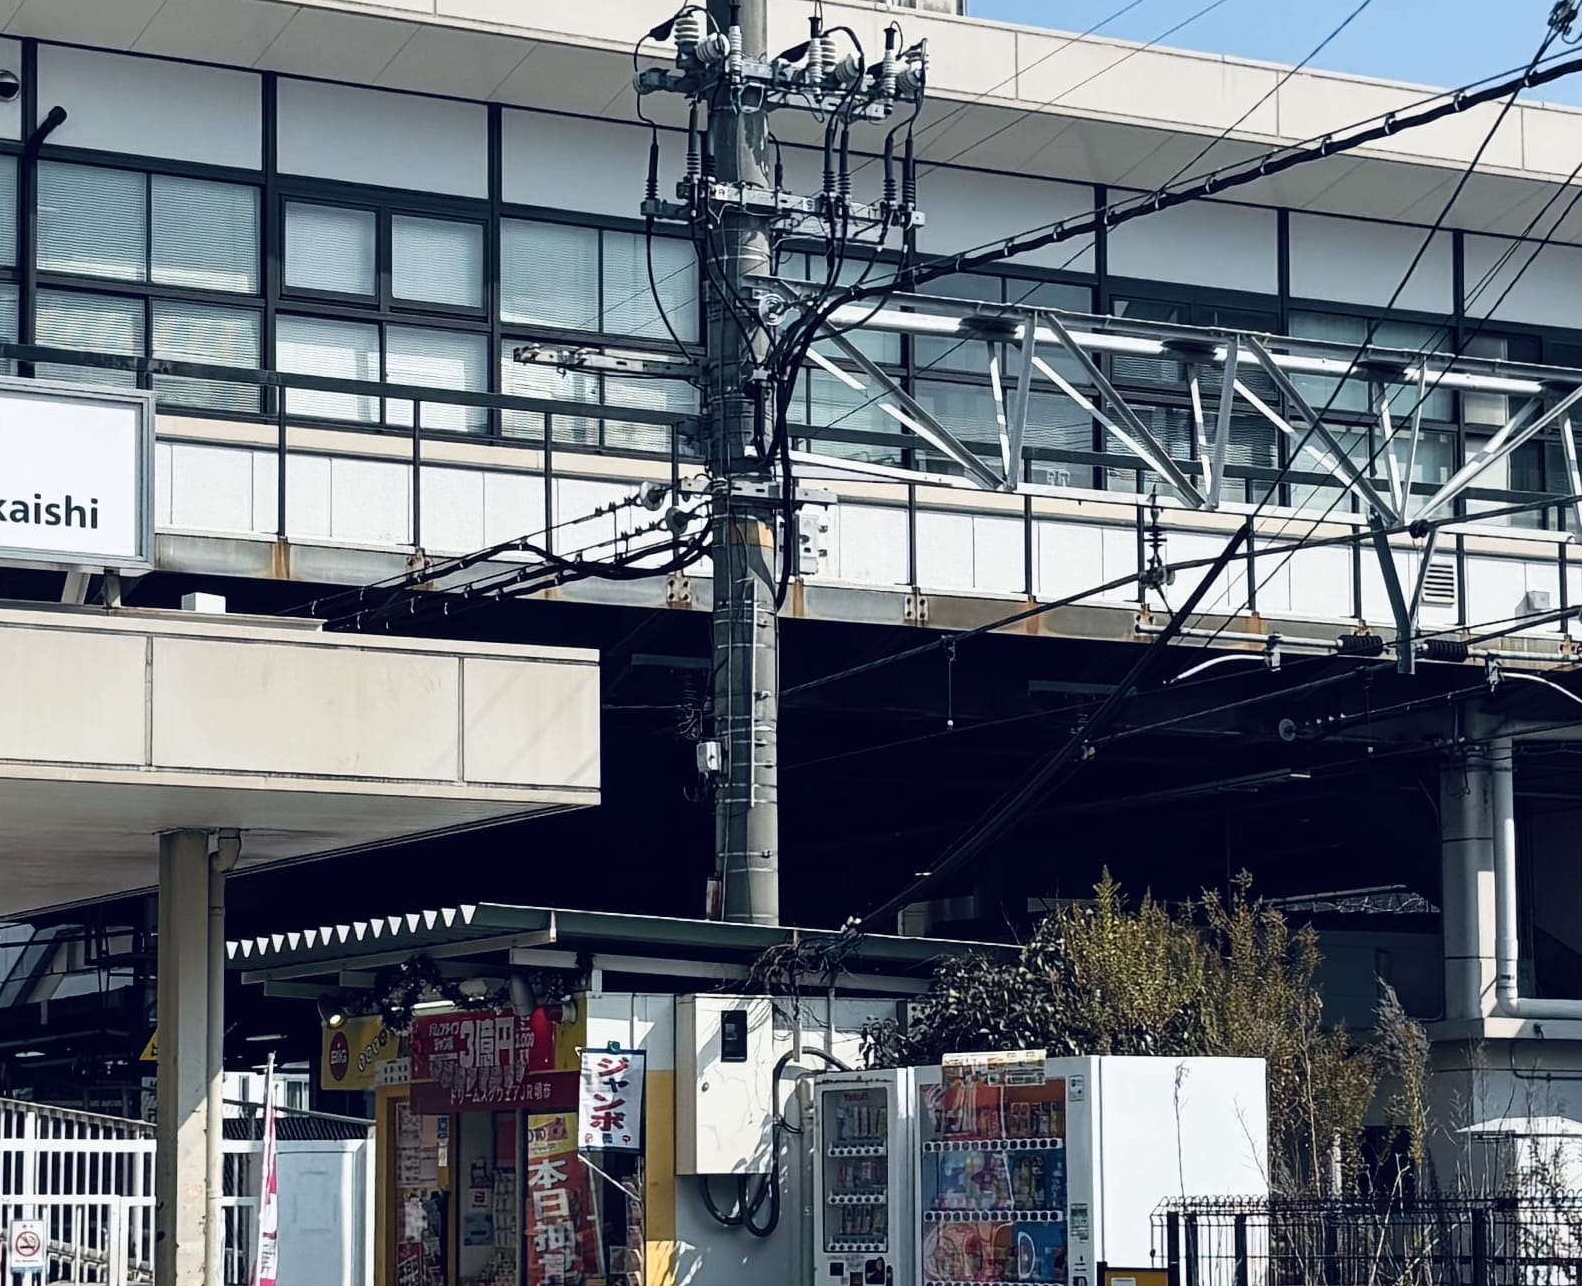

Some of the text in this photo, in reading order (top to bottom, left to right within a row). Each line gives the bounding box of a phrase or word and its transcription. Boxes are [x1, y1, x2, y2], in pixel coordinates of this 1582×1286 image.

[331, 1050, 349, 1064] BIG
[459, 1017, 515, 1068] 3億円
[590, 1057, 629, 1131] ジャンボ
